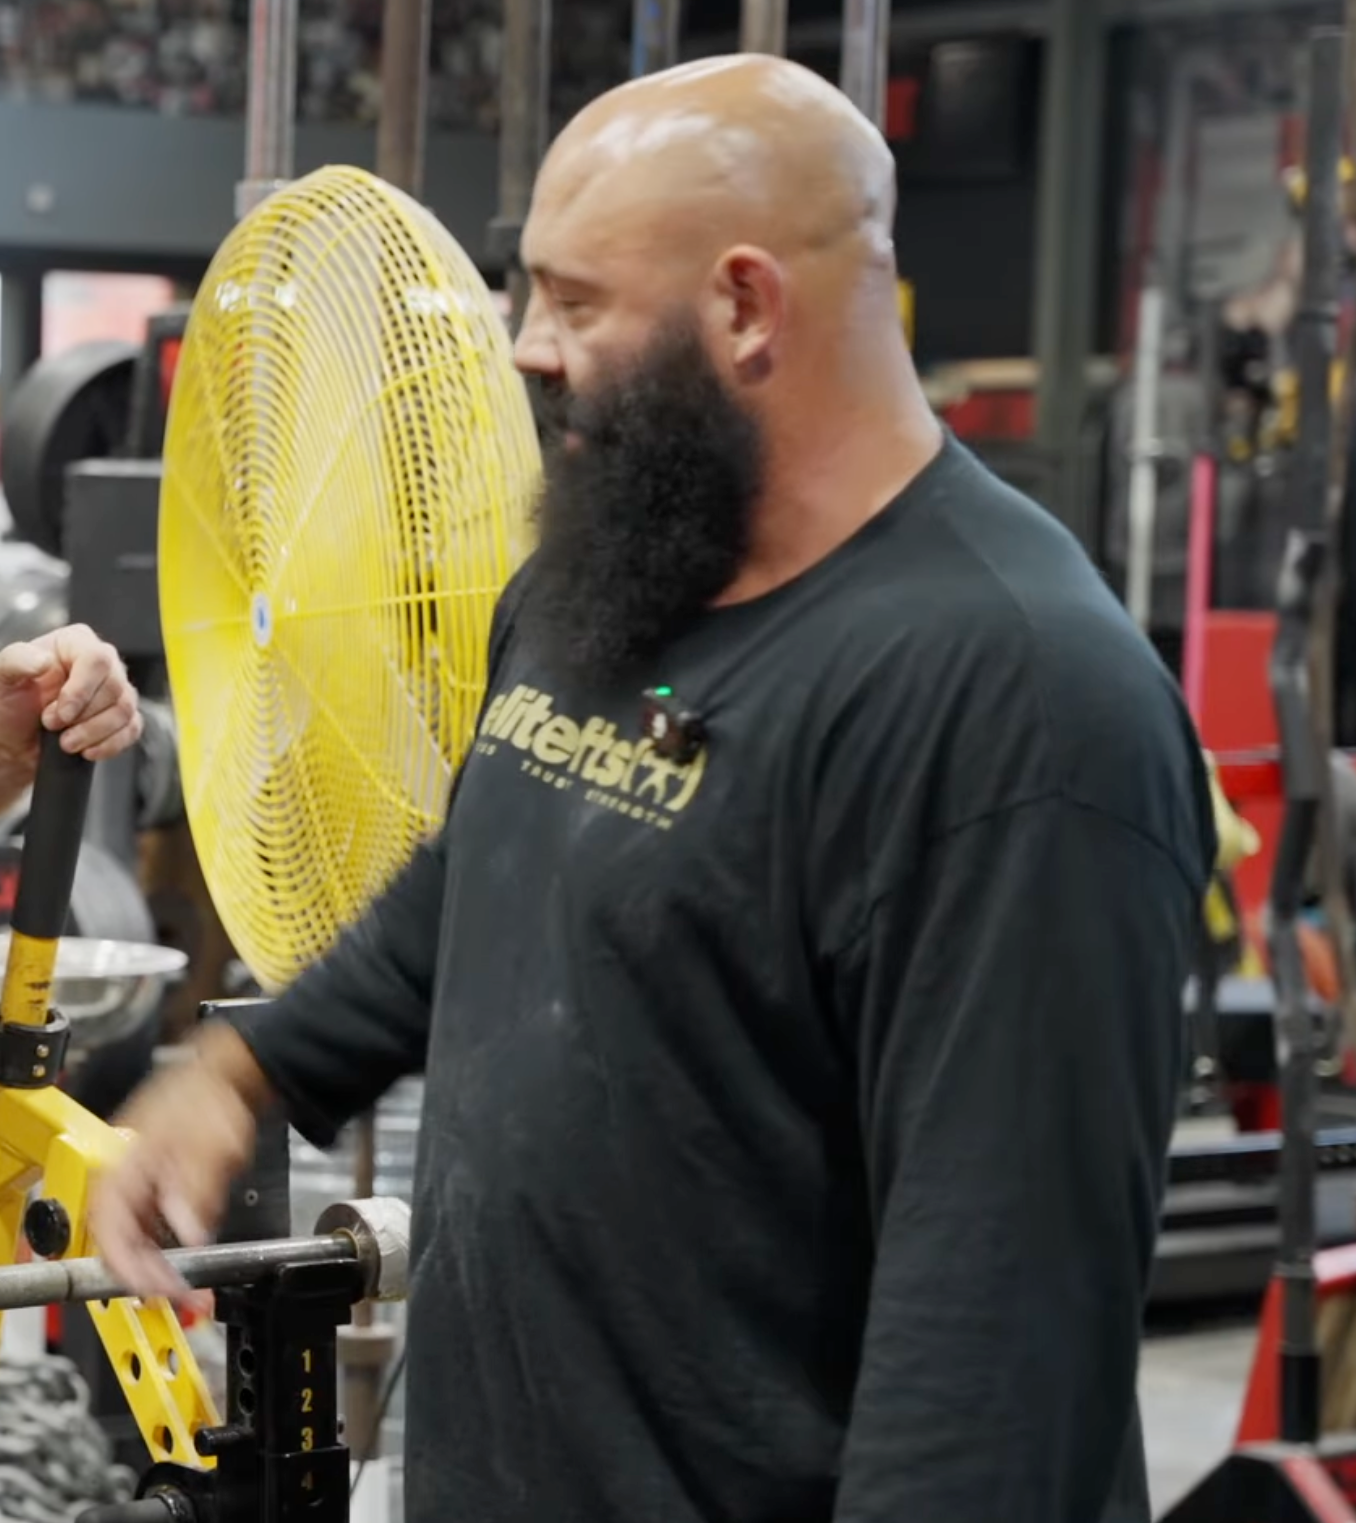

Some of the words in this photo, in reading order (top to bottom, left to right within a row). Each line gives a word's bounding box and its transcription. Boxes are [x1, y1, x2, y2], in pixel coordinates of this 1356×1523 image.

[301, 1349, 312, 1374] 1
[300, 1388, 313, 1413] 2
[300, 1427, 314, 1452] 3
